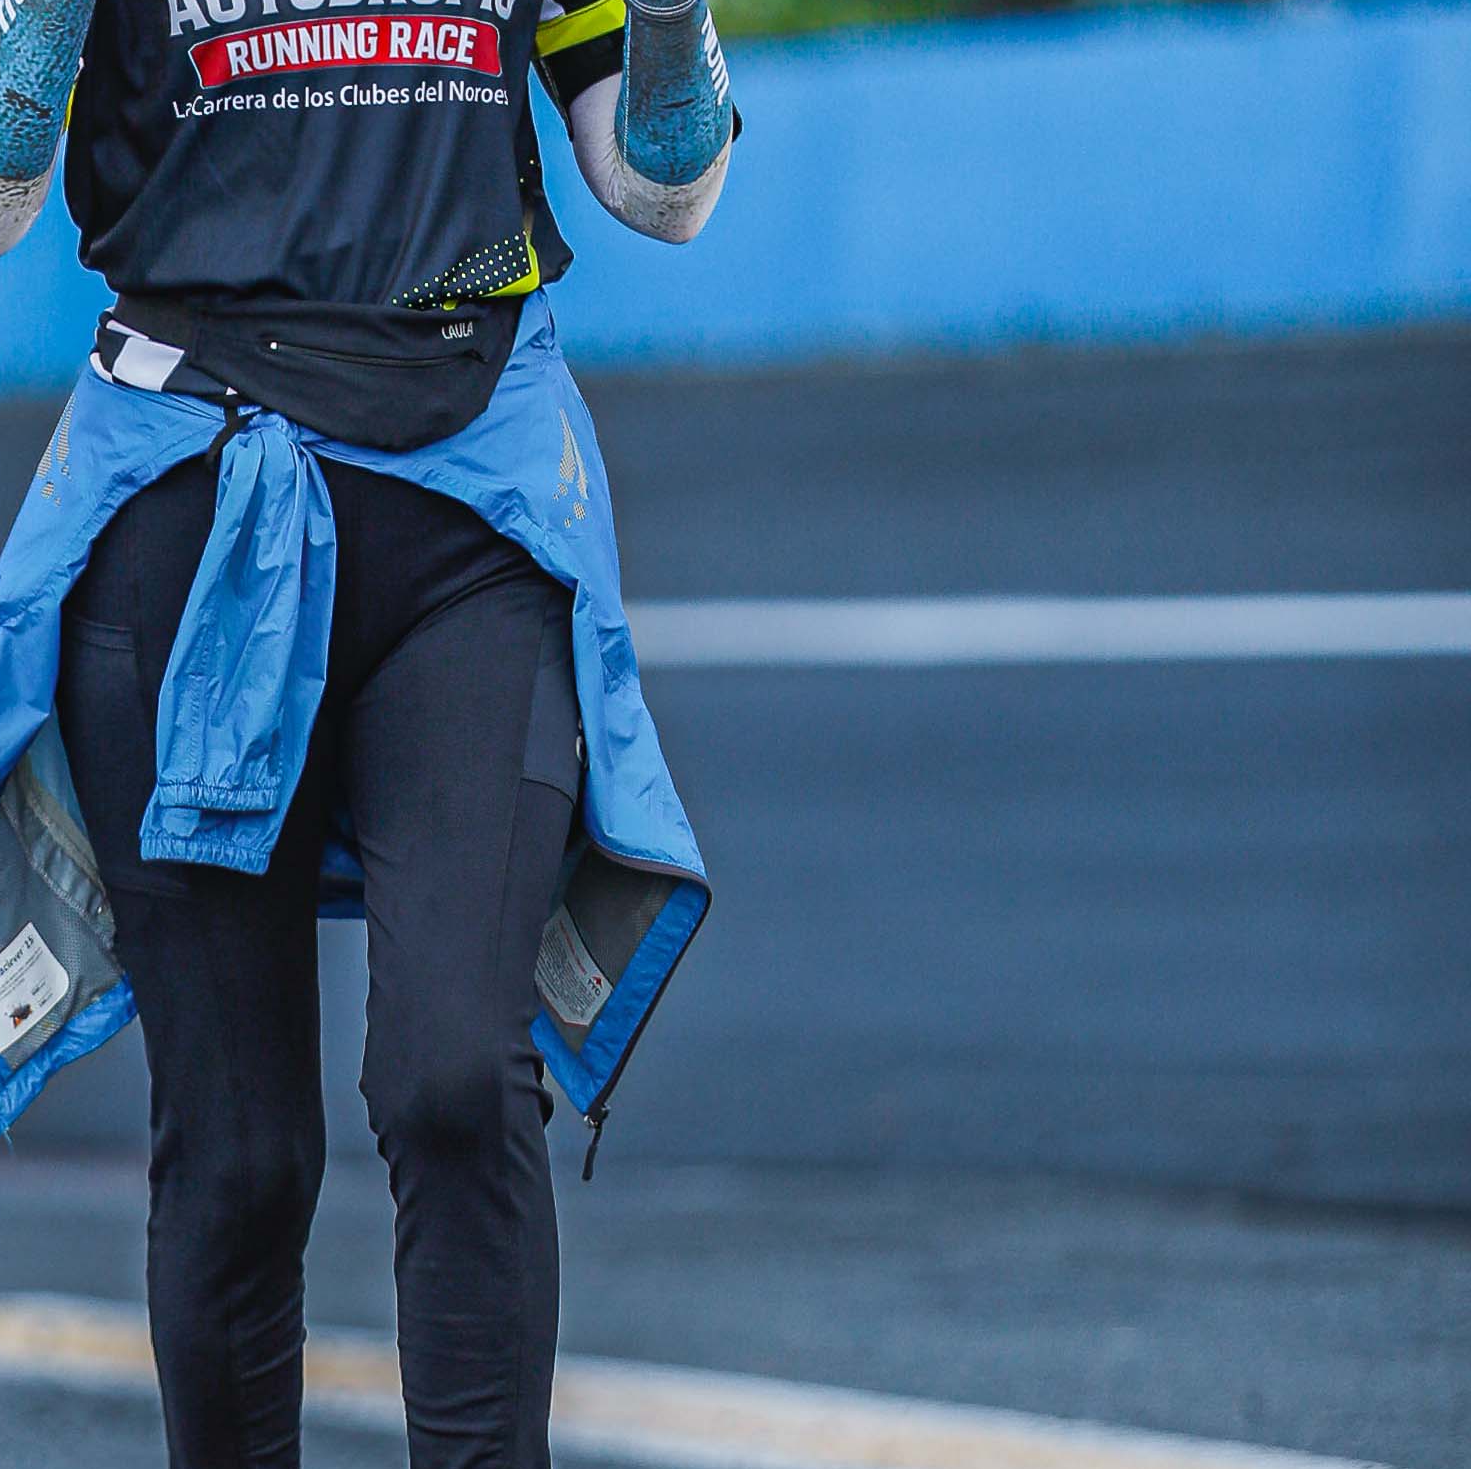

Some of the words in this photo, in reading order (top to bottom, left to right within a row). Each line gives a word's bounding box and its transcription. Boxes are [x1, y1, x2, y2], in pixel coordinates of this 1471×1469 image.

[225, 21, 378, 76] RUNNING
[388, 20, 478, 65] RACE
[192, 93, 267, 116] Carrera
[273, 87, 300, 109] de
[304, 85, 334, 108] los
[340, 83, 410, 107] Clubes
[414, 80, 444, 104] del
